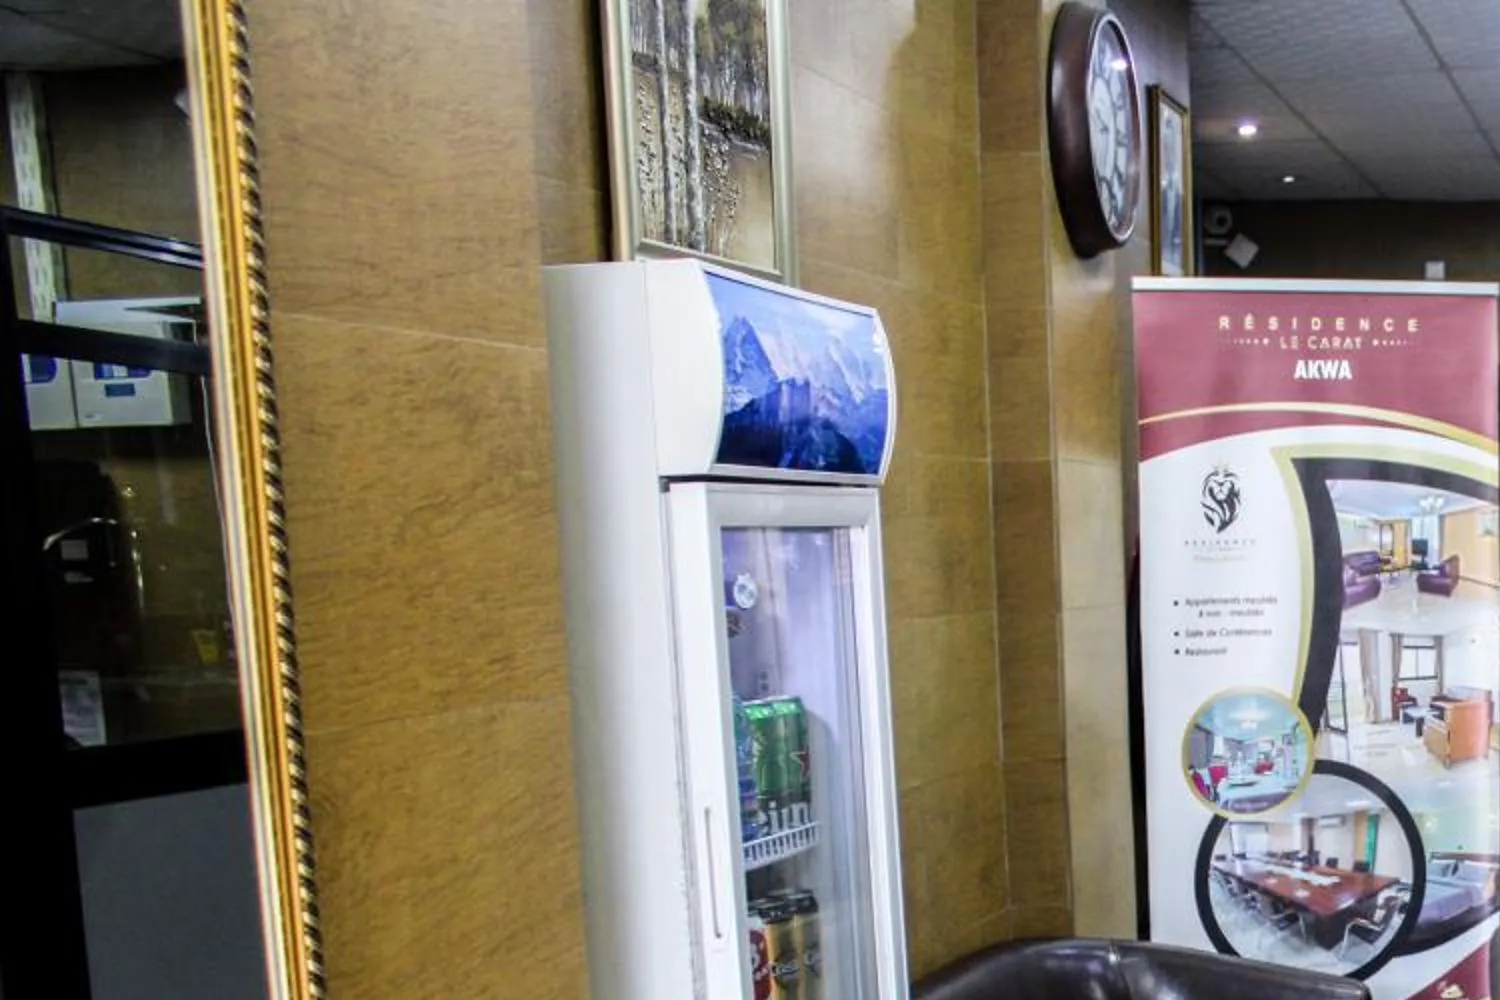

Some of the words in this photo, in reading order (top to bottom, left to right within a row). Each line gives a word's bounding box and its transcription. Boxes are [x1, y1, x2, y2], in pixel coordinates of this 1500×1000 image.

[1218, 313, 1420, 332] RÉSIDENCE
[1279, 336, 1299, 349] LE
[1307, 336, 1362, 349] CARAT
[1293, 359, 1353, 380] AKWA
